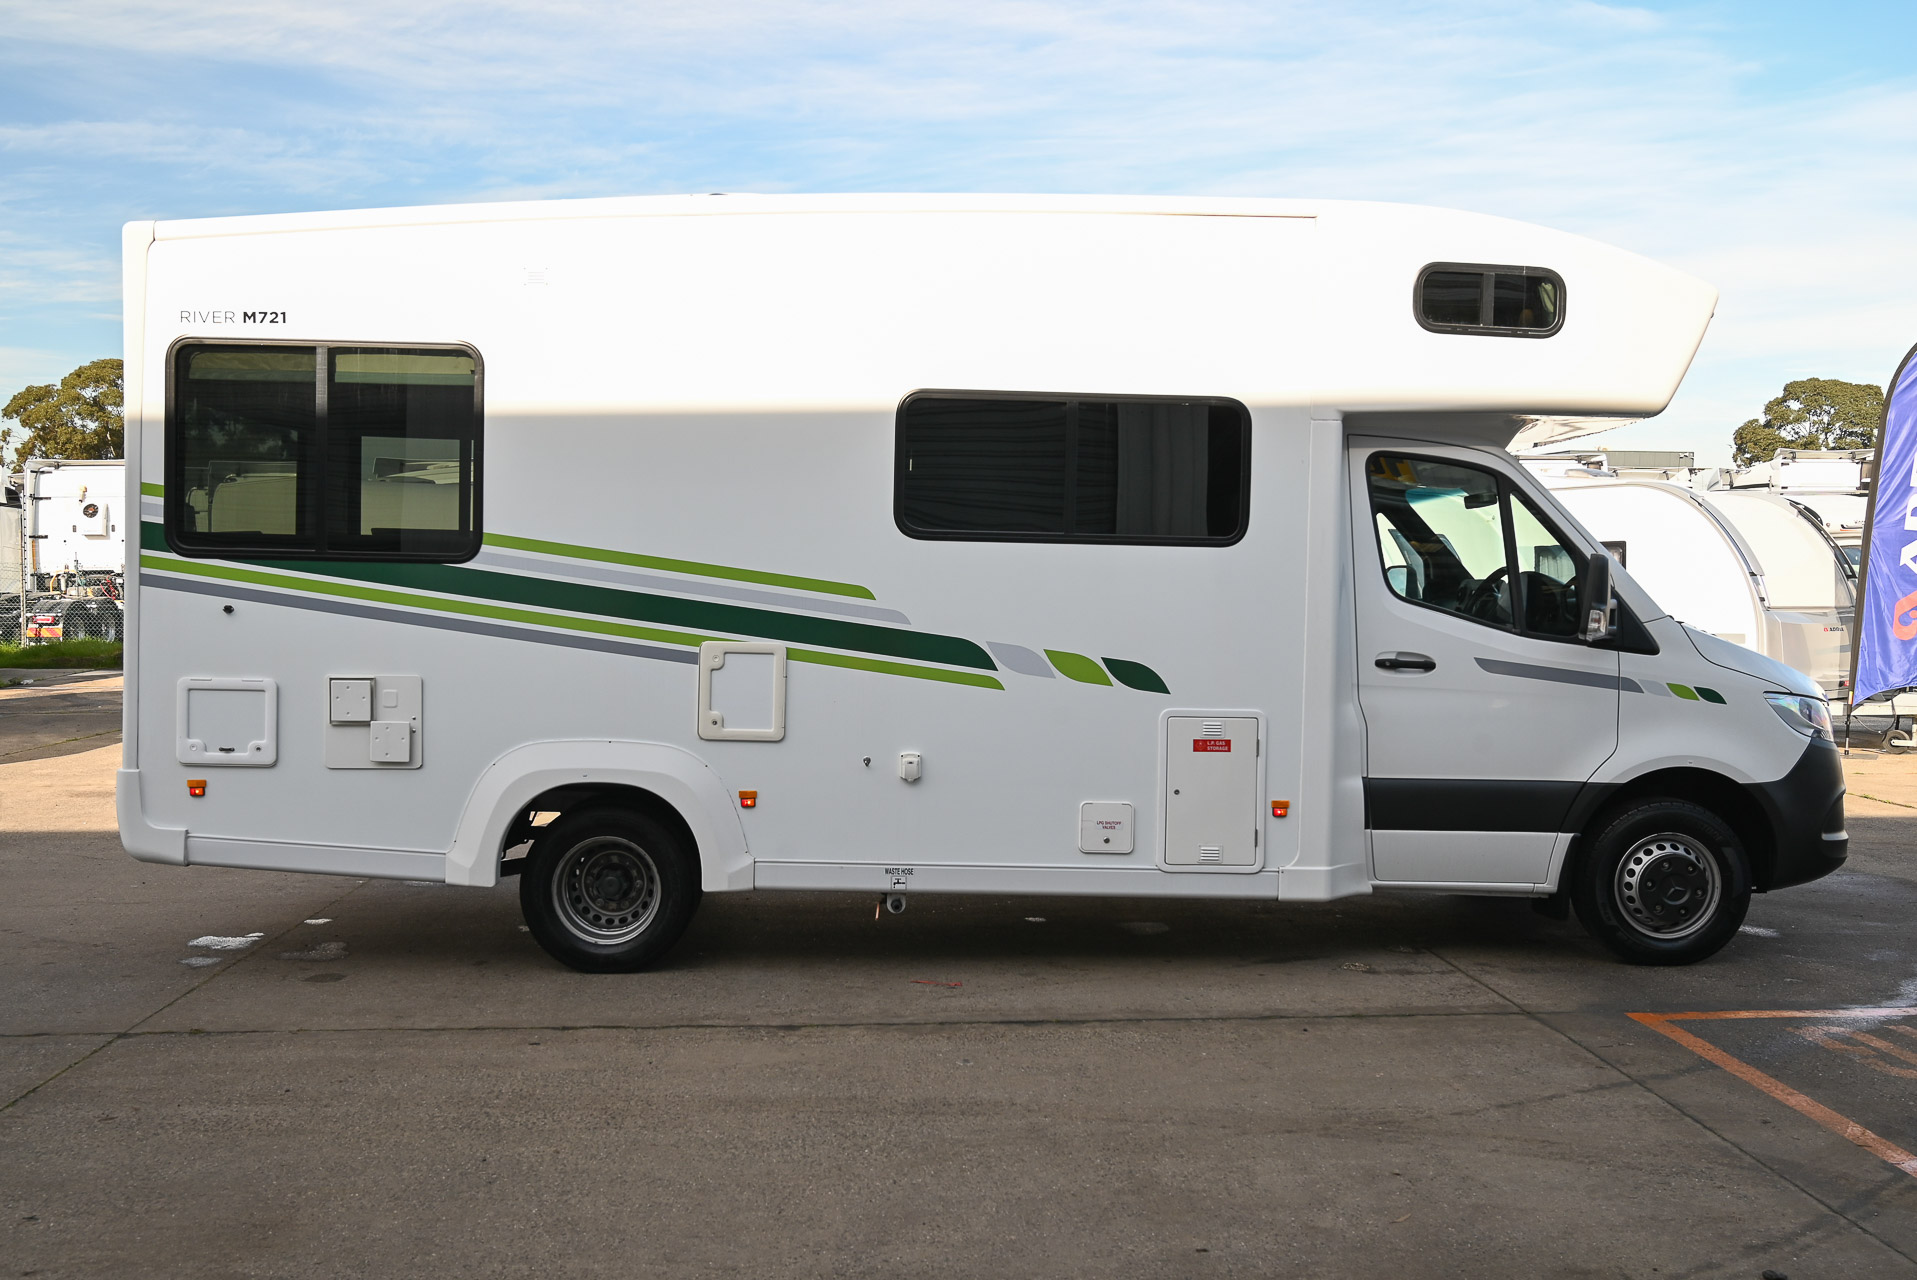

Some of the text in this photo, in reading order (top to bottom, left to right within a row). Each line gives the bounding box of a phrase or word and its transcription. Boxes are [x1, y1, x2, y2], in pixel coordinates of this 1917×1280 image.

[180, 310, 286, 323] RIVER M721
[885, 867, 914, 876] WASTE HOSE
